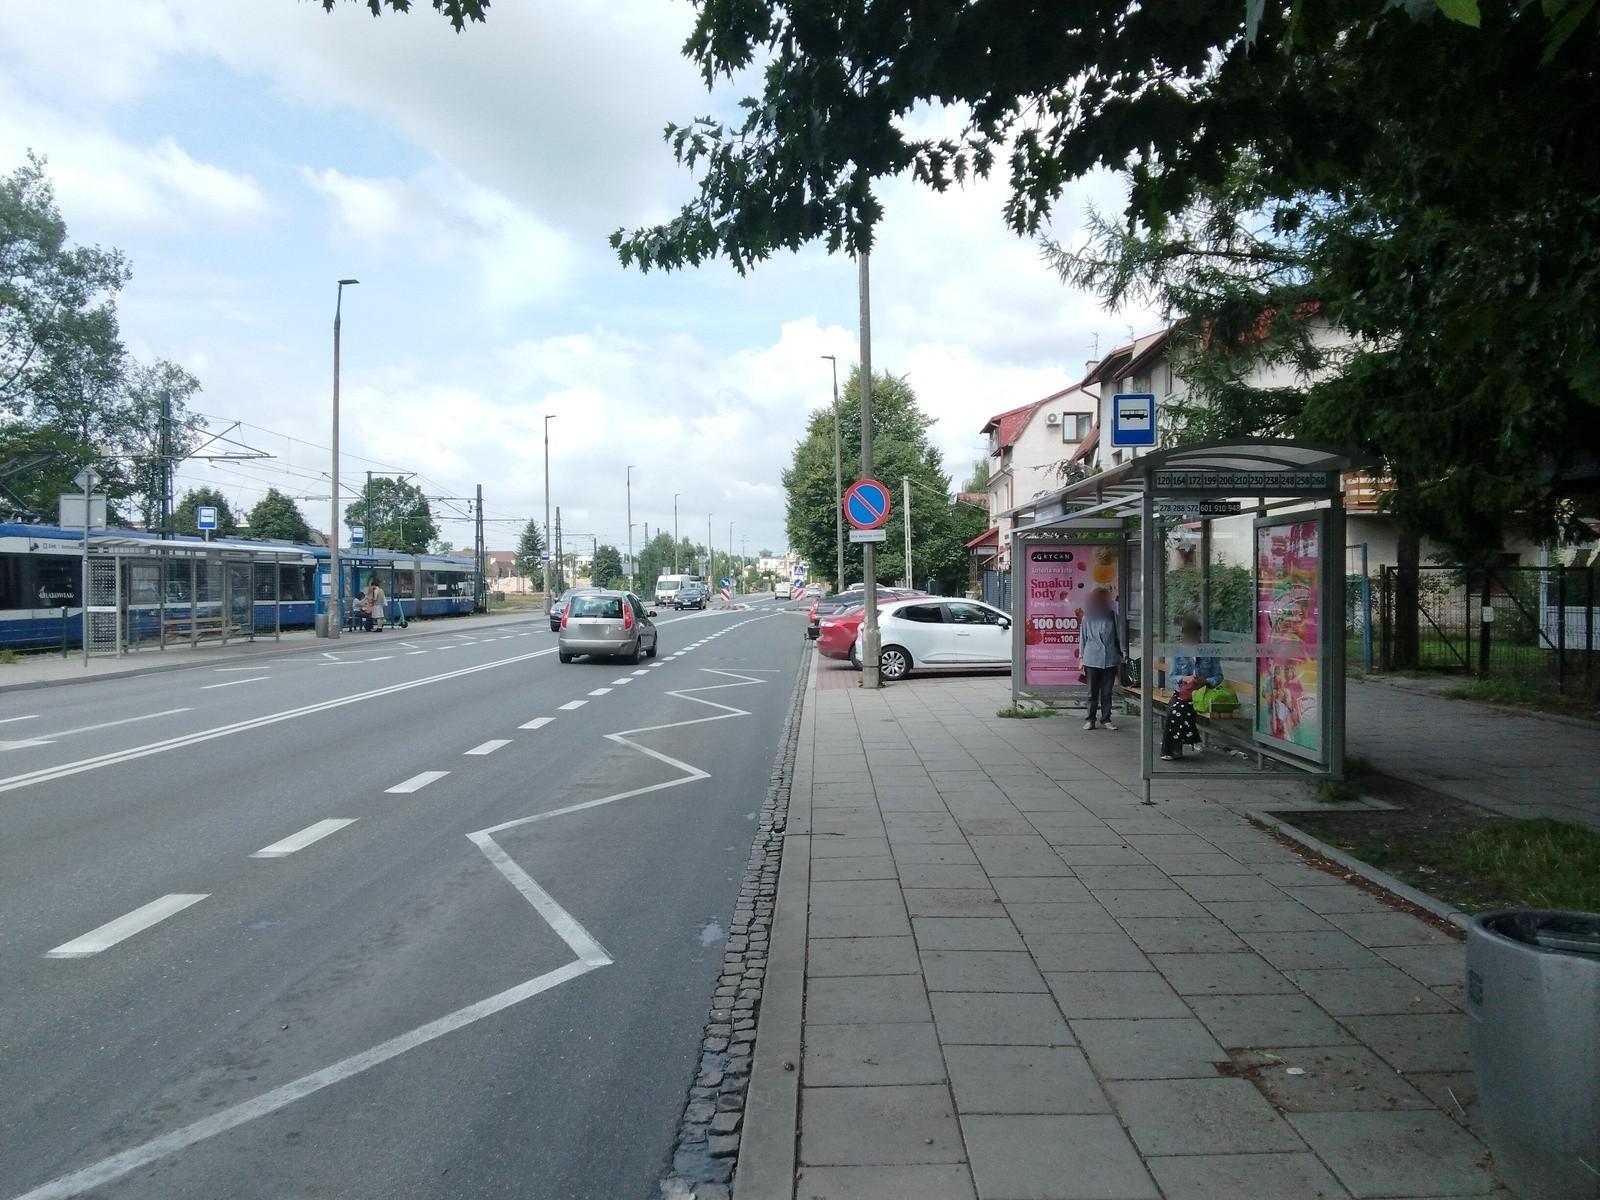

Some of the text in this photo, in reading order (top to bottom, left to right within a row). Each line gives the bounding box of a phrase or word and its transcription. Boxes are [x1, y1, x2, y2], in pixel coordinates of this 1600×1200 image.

[1158, 476, 1171, 485] 120
[1173, 476, 1185, 485] 164
[1190, 476, 1200, 485] 172
[1205, 476, 1217, 485] 199
[1219, 476, 1232, 485] 200
[1234, 476, 1248, 485] 210
[1250, 476, 1263, 485] 230
[1031, 577, 1073, 590] Smakuj
[1032, 588, 1056, 600] lody
[1033, 619, 1077, 629] 100 000
